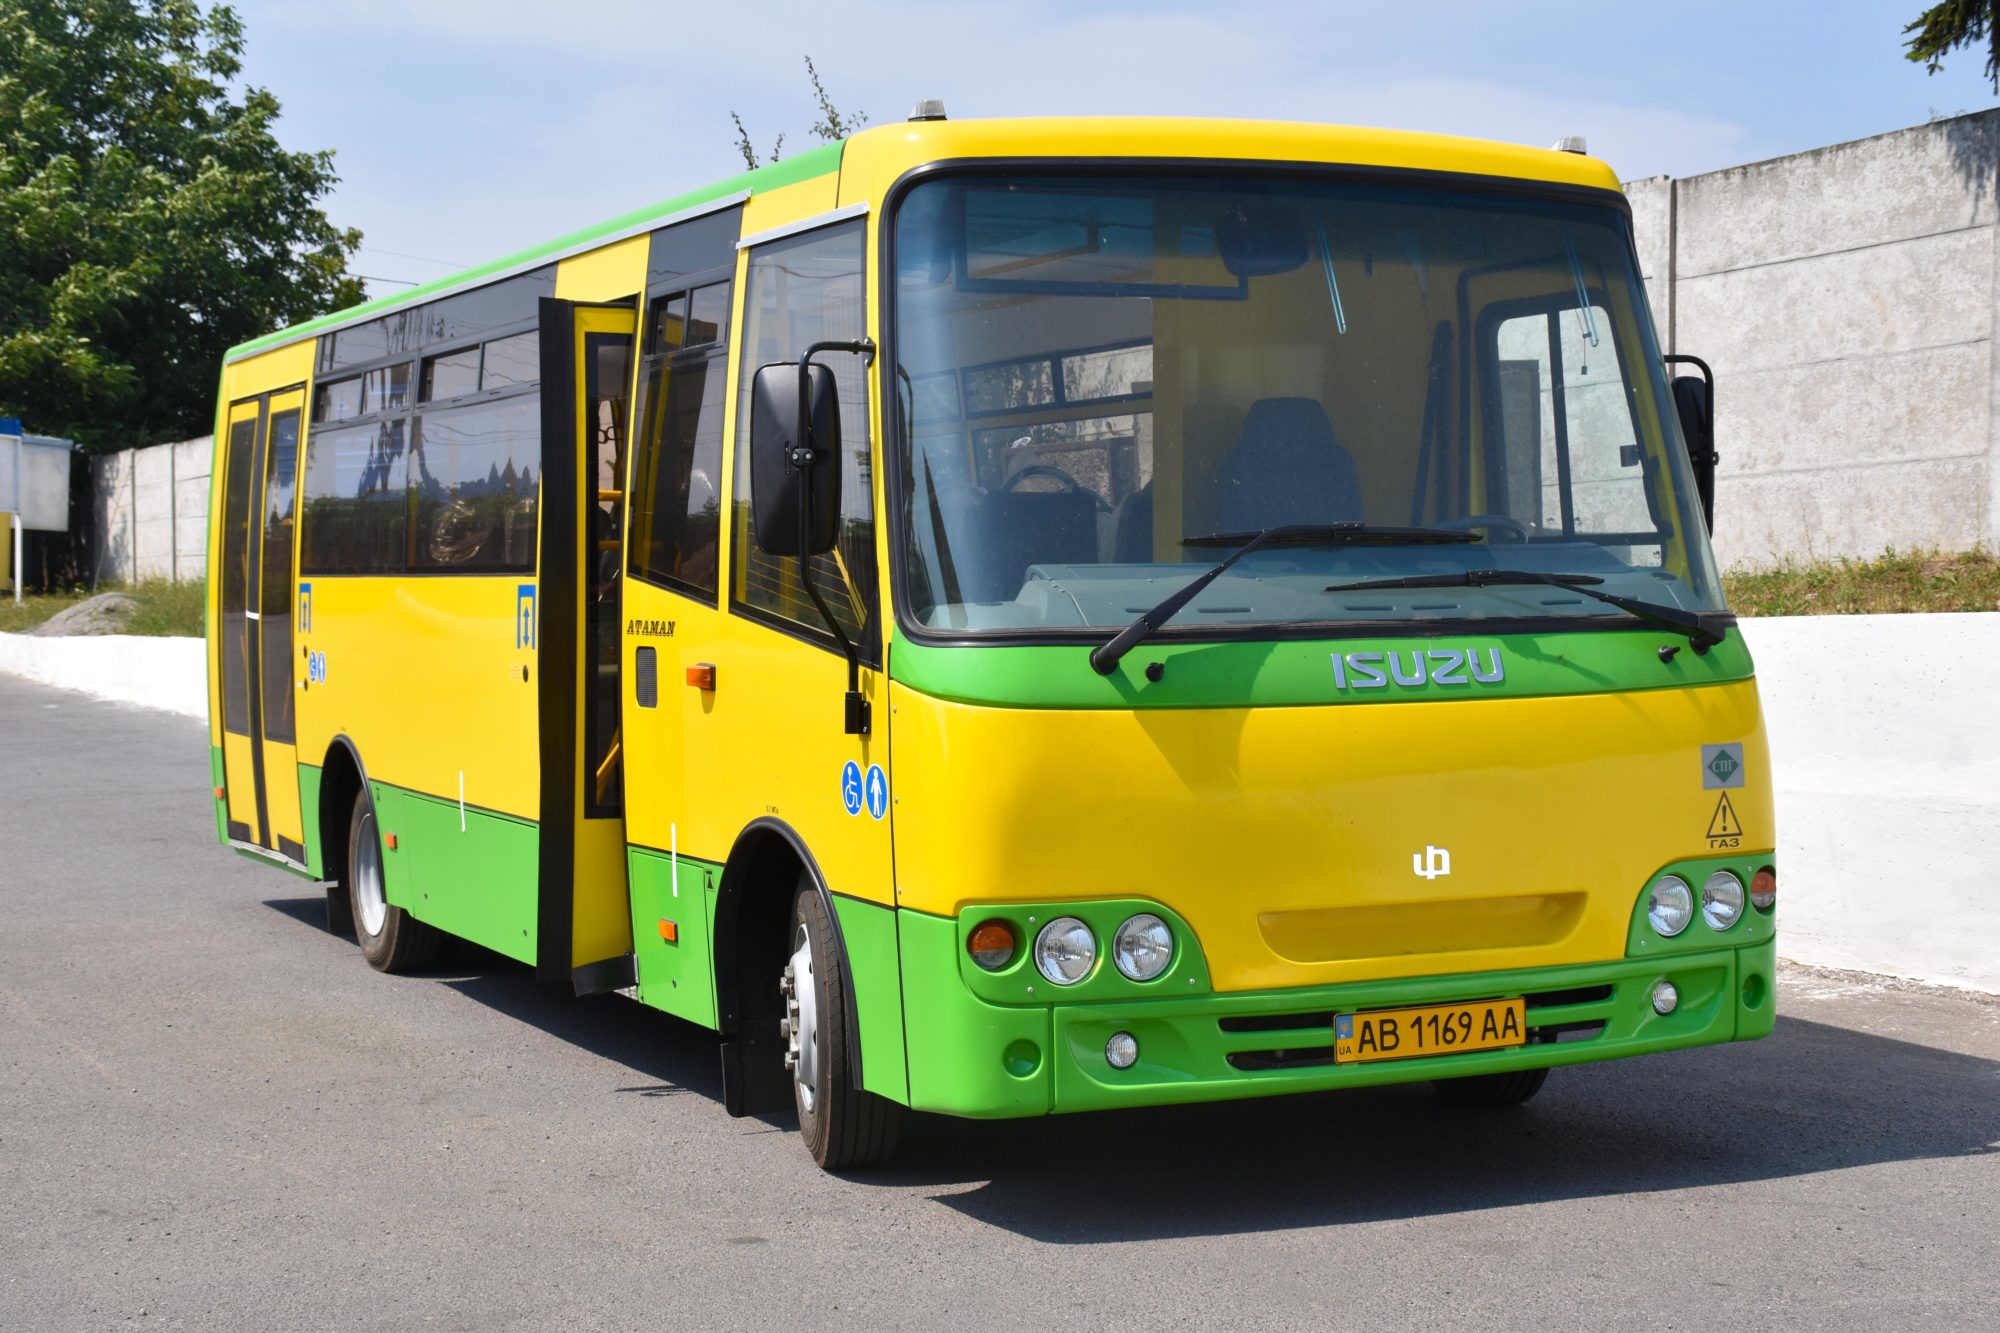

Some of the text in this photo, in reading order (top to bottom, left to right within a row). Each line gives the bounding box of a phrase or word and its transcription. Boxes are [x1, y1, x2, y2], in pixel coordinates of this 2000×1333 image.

[626, 619, 676, 637] ATAMAN
[1331, 648, 1504, 689] ISUZU
[1710, 838, 1740, 849] ГАЗ
[1358, 1006, 1519, 1053] AB 1169 AA
[1338, 1045, 1352, 1056] UA
